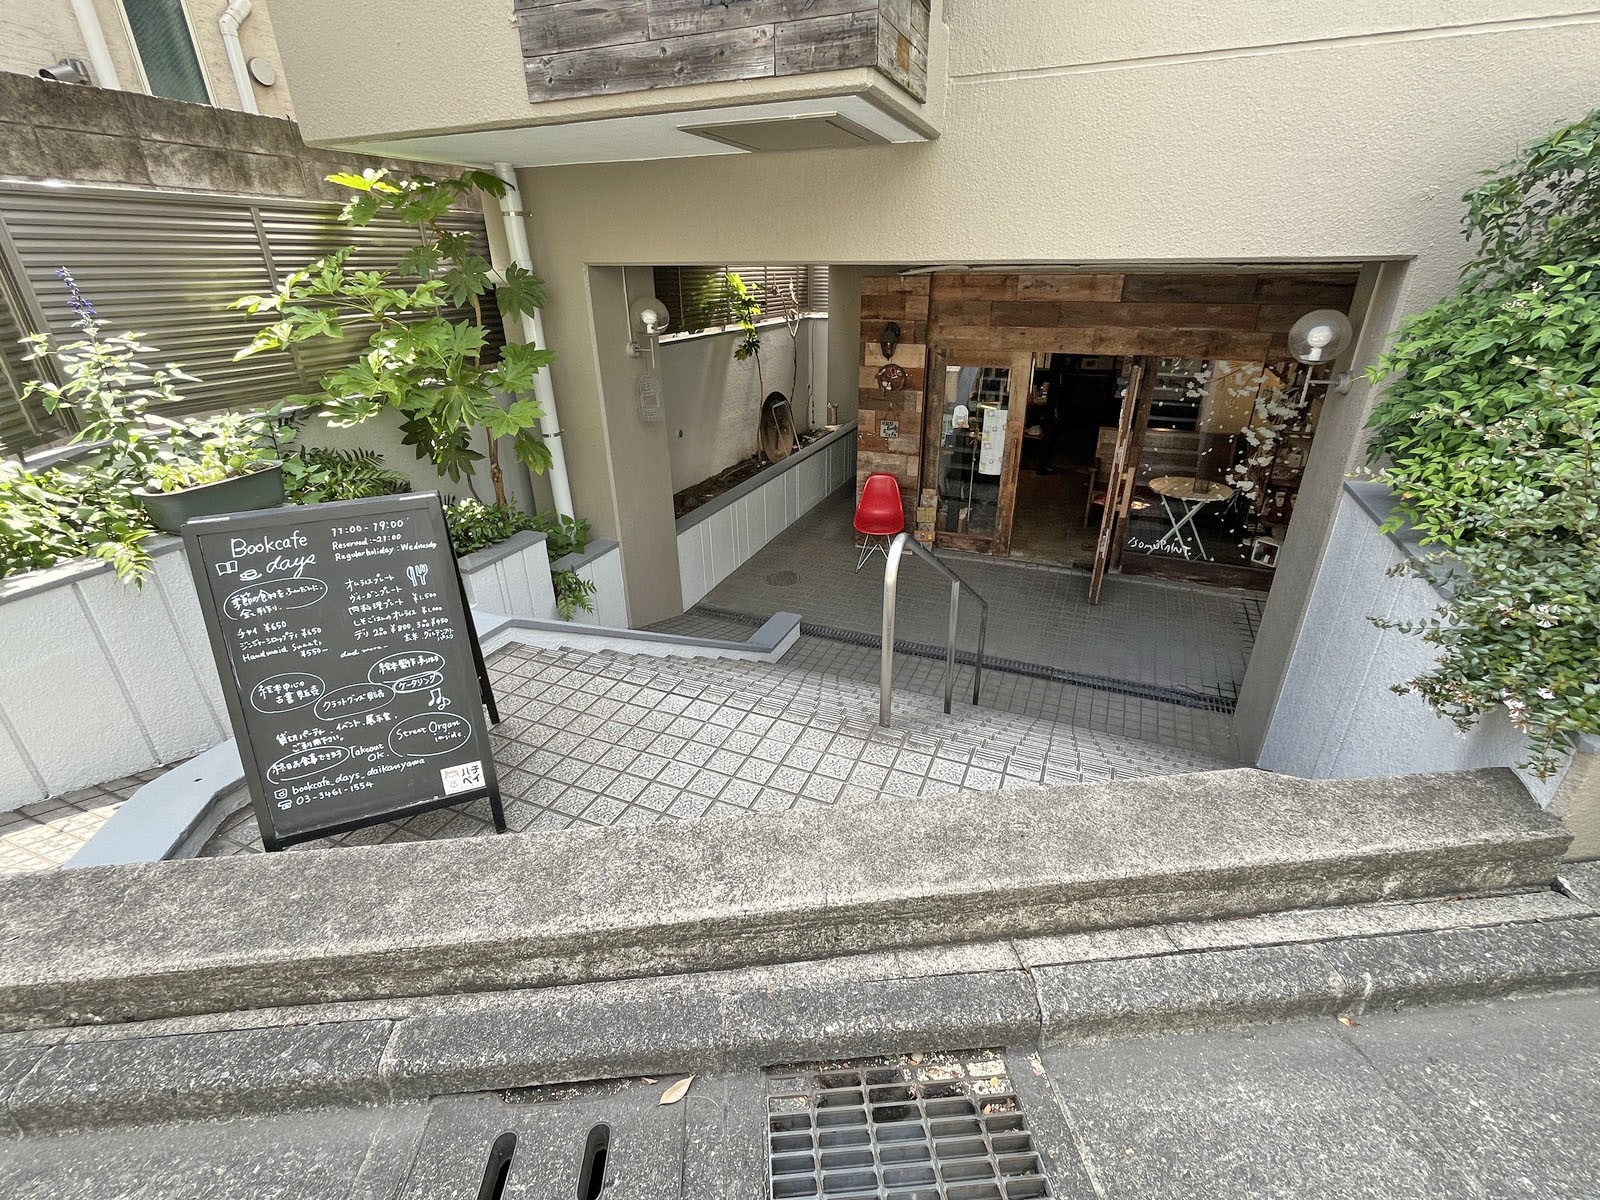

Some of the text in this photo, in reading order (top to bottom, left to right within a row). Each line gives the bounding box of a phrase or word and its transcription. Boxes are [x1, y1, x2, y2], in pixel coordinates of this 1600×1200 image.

[331, 525, 362, 537] 11:00
[373, 520, 404, 532] 19:00
[231, 530, 308, 558] Bookcafe
[266, 554, 316, 579] days
[263, 621, 287, 632] ¥650
[301, 627, 322, 638] ¥650
[399, 675, 436, 691] ケータリング
[429, 720, 461, 733] Organ
[462, 765, 480, 776] ハチ
[296, 782, 374, 805] 03-3461-1554
